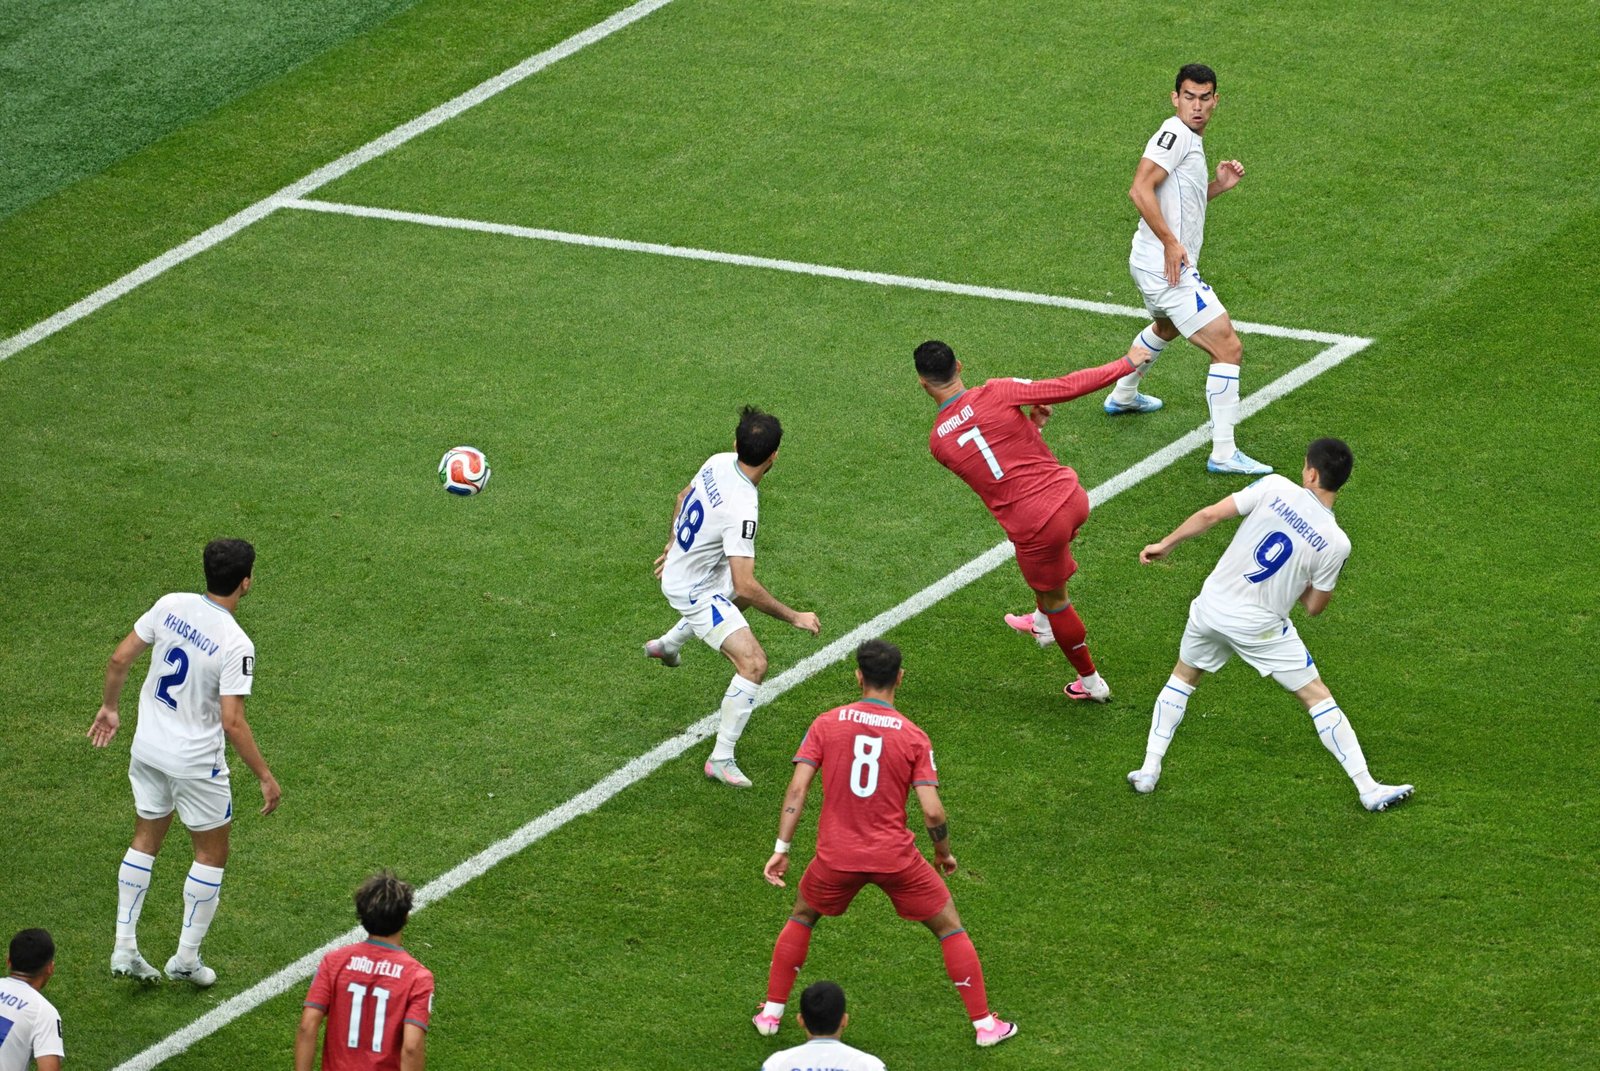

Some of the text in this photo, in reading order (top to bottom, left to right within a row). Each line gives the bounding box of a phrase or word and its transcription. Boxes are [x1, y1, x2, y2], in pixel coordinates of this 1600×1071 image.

[956, 425, 1004, 480] 7
[1268, 496, 1329, 552] XAMROBEKOV
[1243, 530, 1293, 584] 9
[163, 613, 220, 656] KHUSANOV
[155, 647, 189, 711] 2
[849, 734, 883, 798] 8
[346, 955, 404, 979] JOÃO FÉLIX
[0, 991, 29, 1010] MOV
[347, 982, 390, 1053] 11
